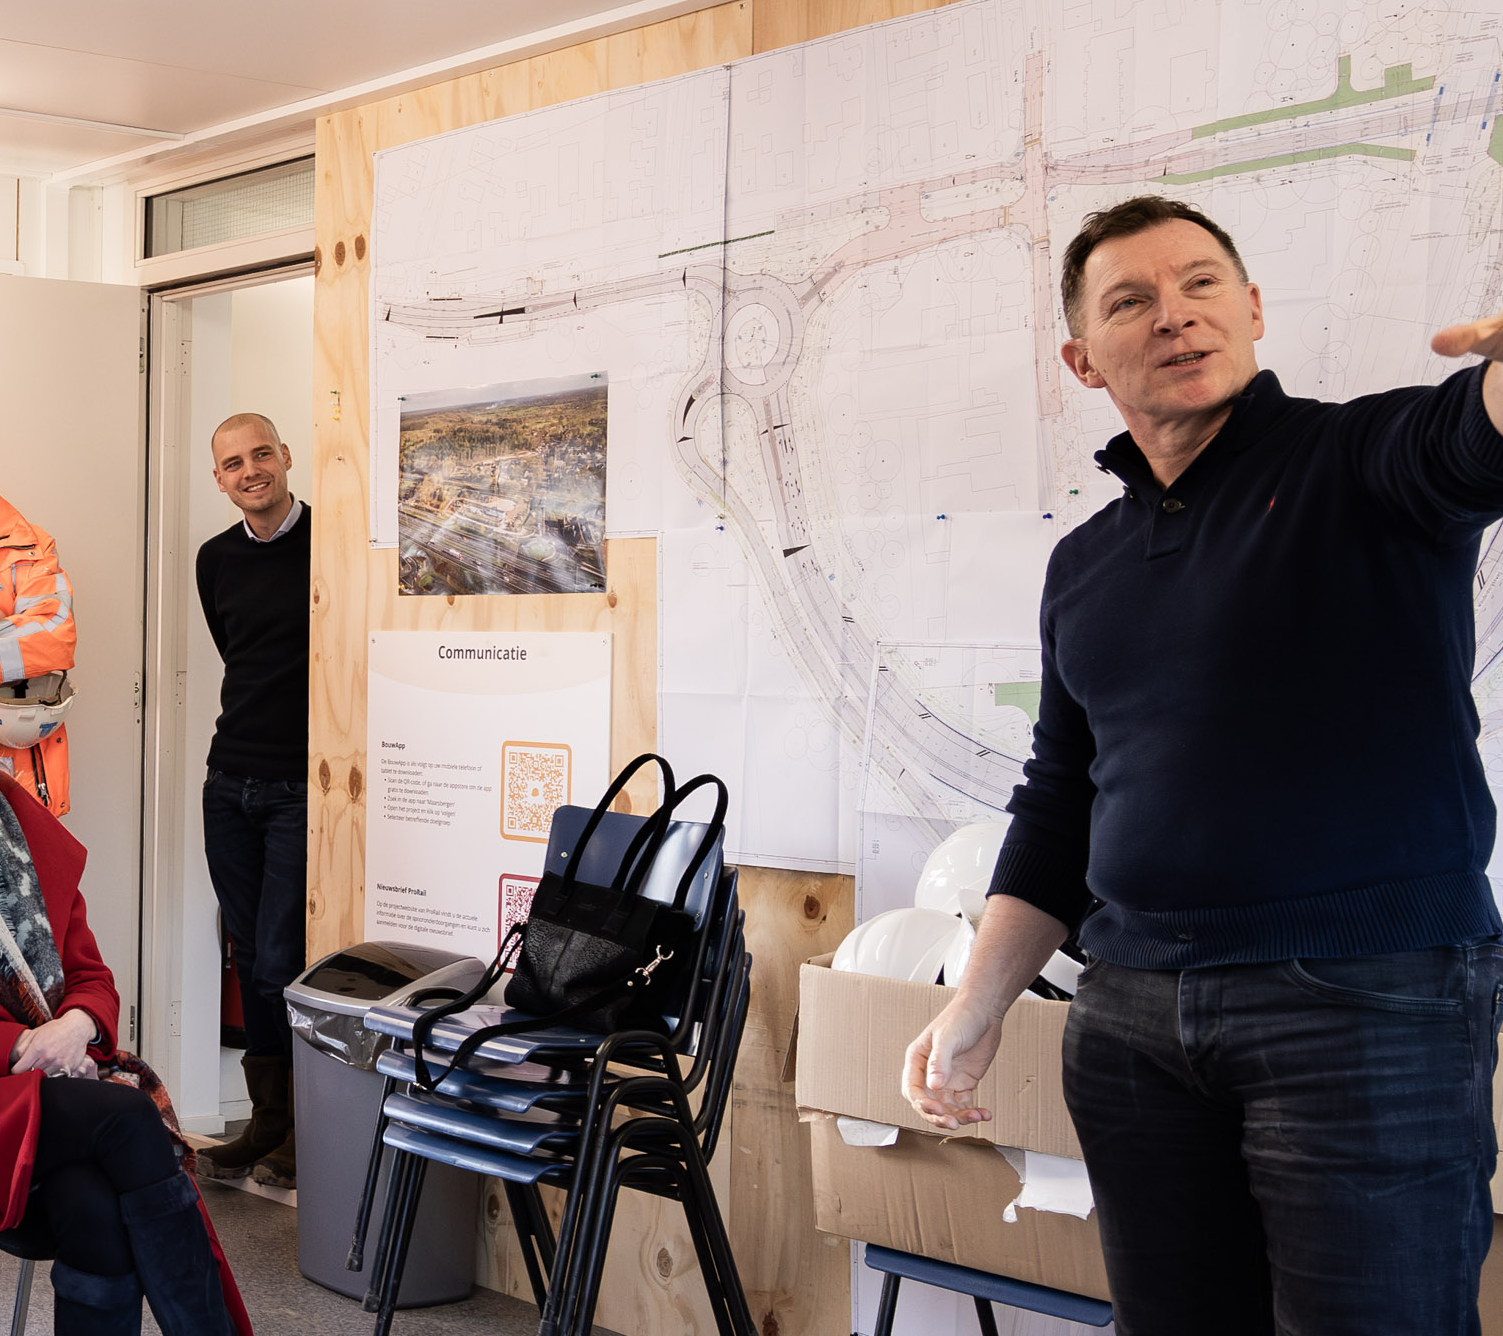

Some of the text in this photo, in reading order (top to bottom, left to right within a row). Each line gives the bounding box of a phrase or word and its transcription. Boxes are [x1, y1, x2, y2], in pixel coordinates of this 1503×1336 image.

[438, 646, 527, 661] Communicatie
[381, 741, 405, 750] BouwApp
[377, 883, 426, 897] Nieuwsbrief ProRail
